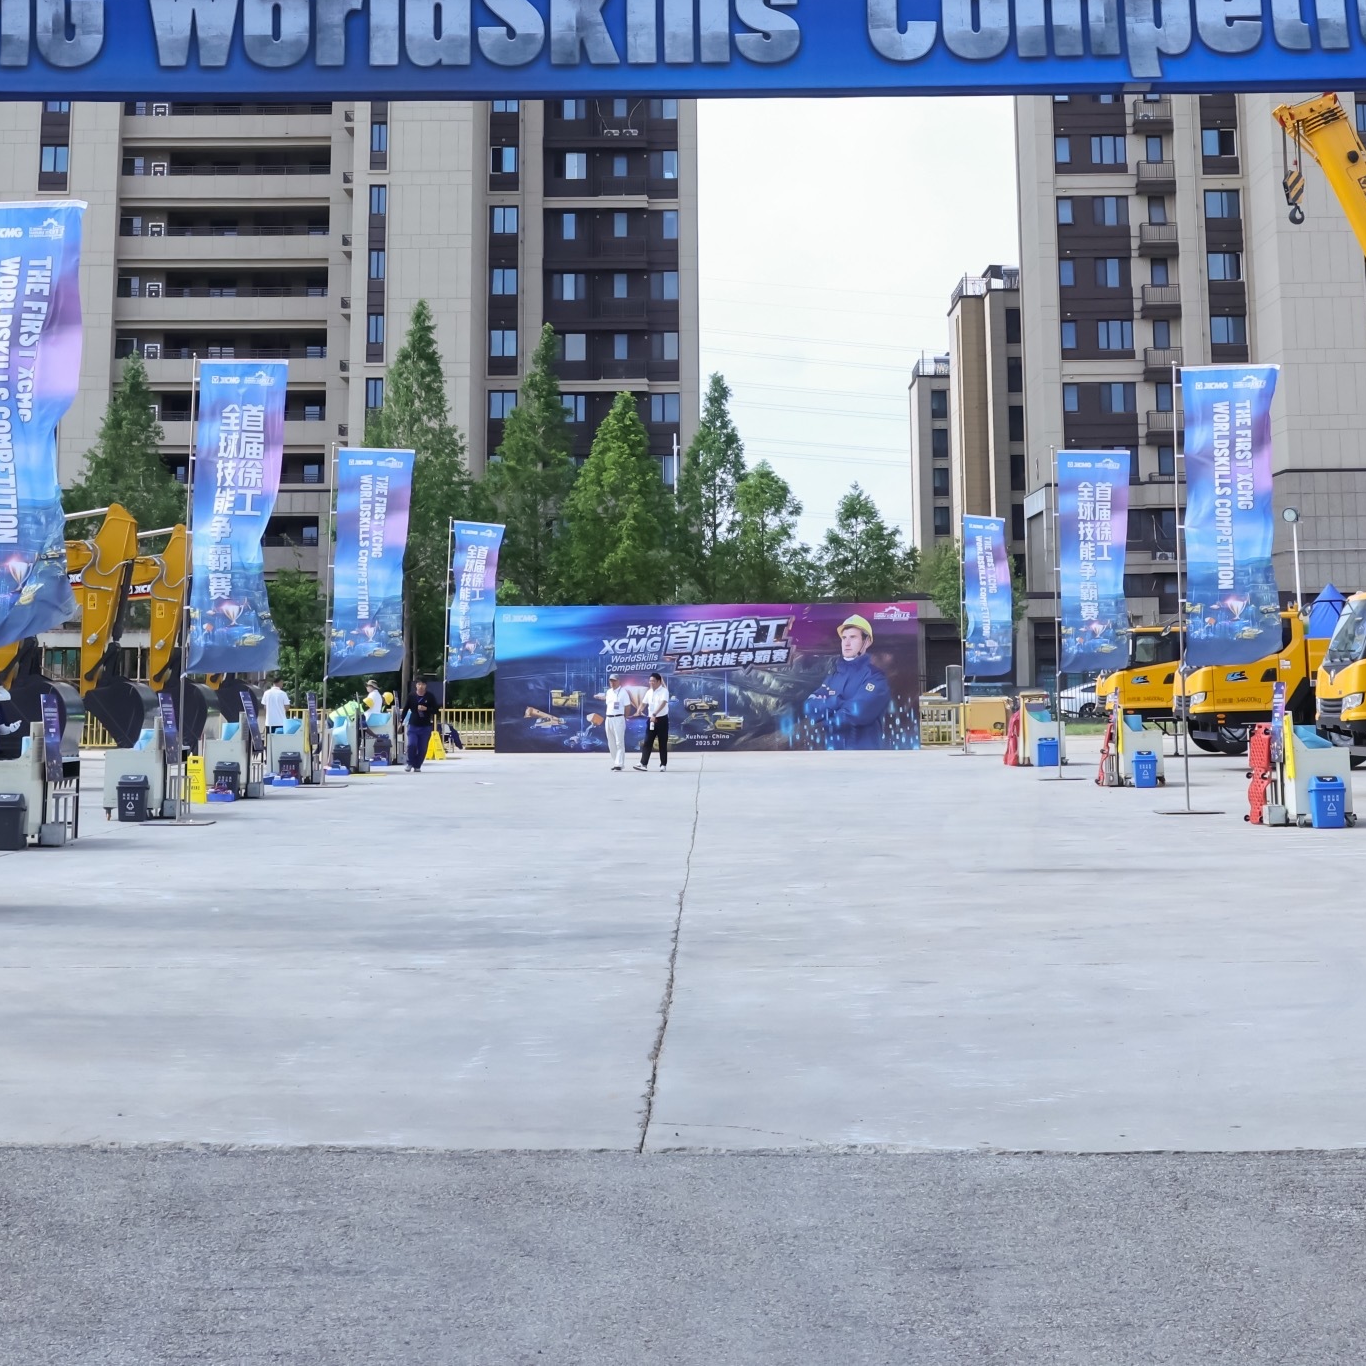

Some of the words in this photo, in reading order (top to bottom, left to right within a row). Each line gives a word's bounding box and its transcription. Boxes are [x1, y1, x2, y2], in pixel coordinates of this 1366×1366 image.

[25, 256, 52, 296] THE
[18, 300, 49, 360] FIRST
[16, 365, 36, 424] XCMG
[1235, 400, 1252, 427] THE
[235, 404, 266, 517] 首届徐工
[1212, 401, 1232, 496] WORLDSKILLS
[1235, 429, 1253, 469] FIRST
[207, 404, 242, 601] 全球技能争霸赛
[375, 475, 389, 496] THE
[1236, 473, 1254, 511] XCMG
[358, 474, 373, 548] WORLDSKILLS
[1095, 482, 1113, 561] 首届徐工
[372, 529, 385, 559] XCMG
[1077, 482, 1099, 621] 全球技能争霸赛
[1214, 497, 1235, 590] COMPETITION
[357, 548, 369, 620] COMPETITION
[599, 636, 662, 655] XCMG
[626, 625, 645, 637] The
[646, 624, 662, 637] 1st
[666, 617, 789, 654] 首届徐工
[605, 662, 657, 673] Competition
[611, 653, 659, 664] WorldSkills
[677, 648, 789, 670] 全球技能争霸赛
